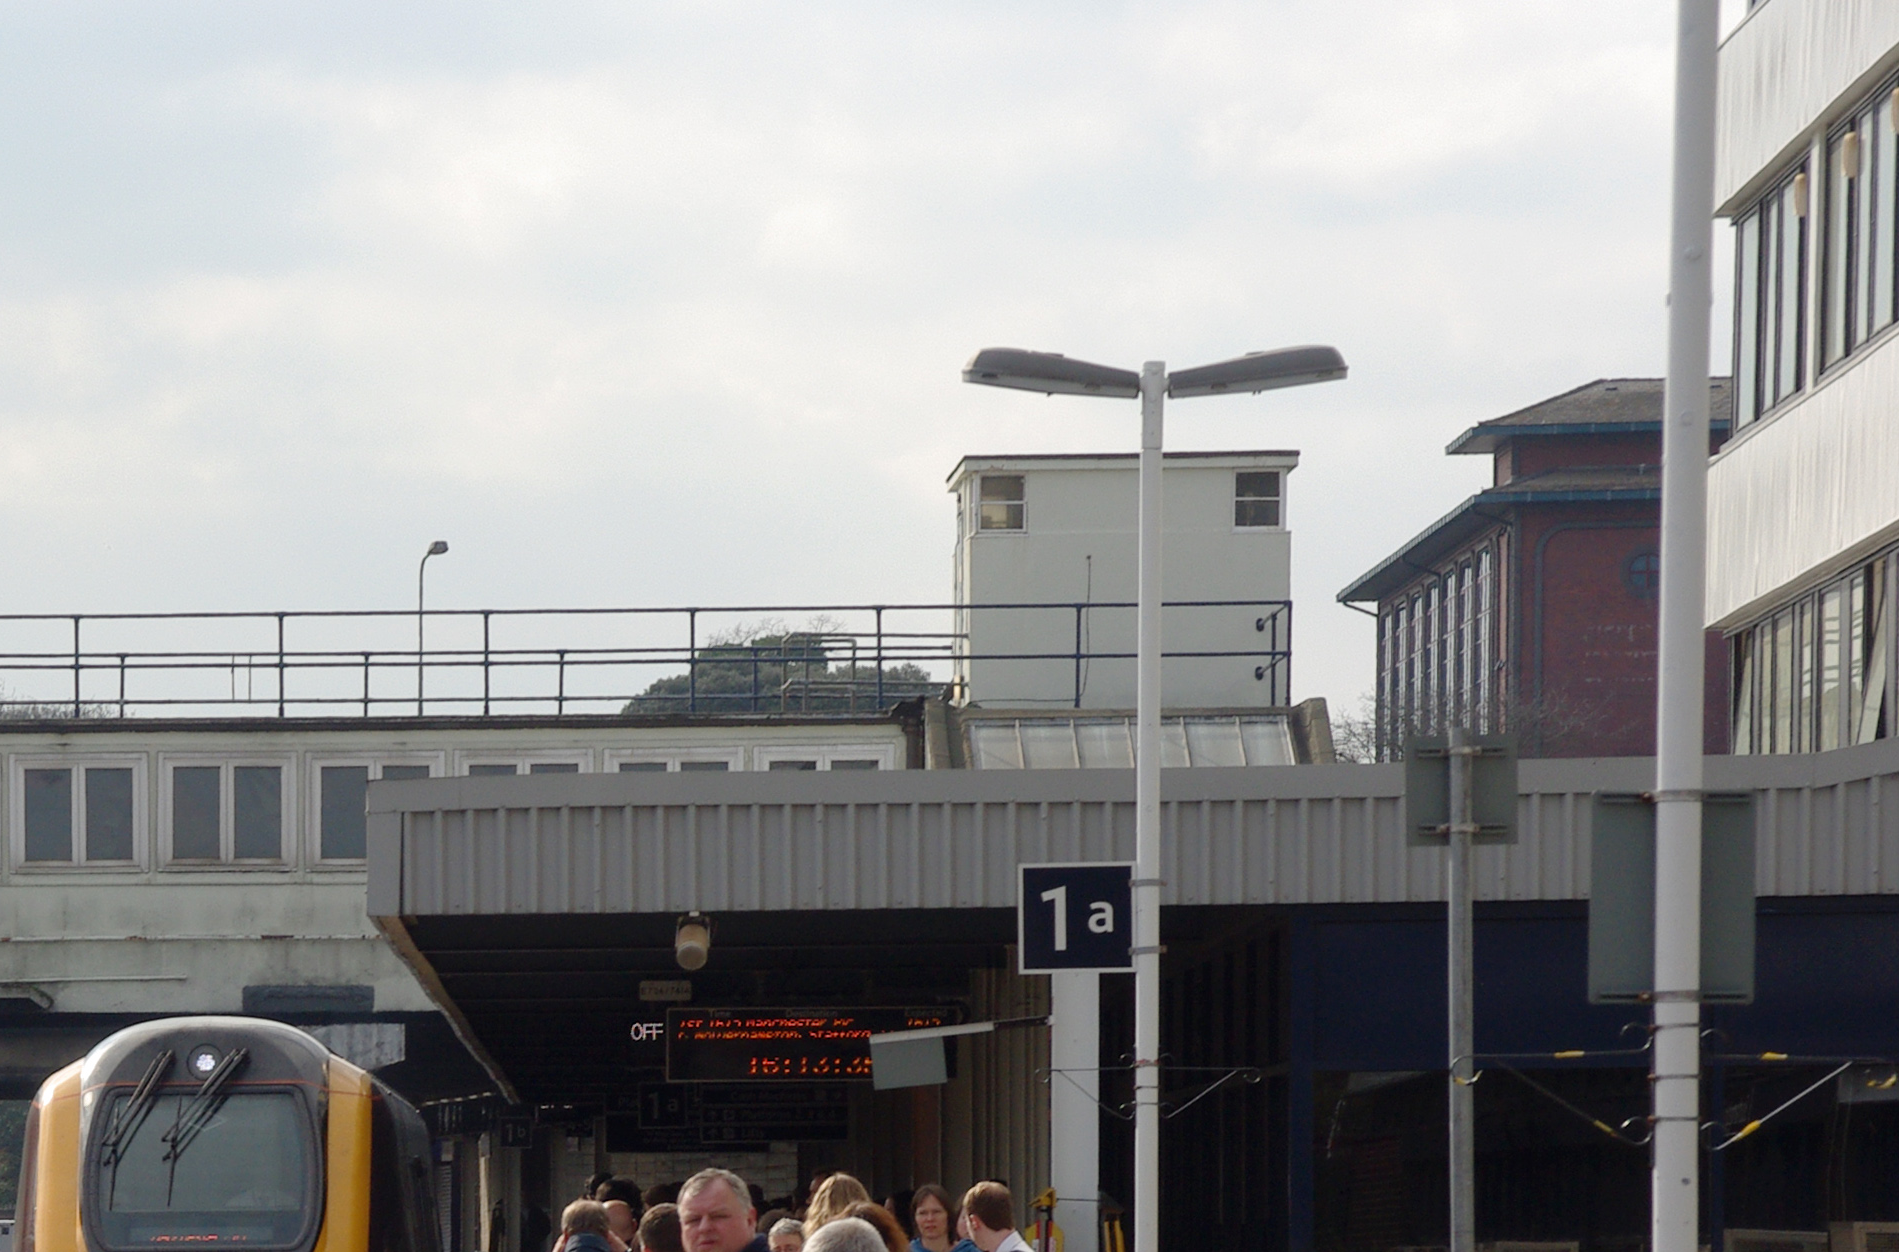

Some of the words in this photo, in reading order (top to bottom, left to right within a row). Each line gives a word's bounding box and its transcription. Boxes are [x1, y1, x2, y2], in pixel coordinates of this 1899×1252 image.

[1040, 886, 1115, 952] 1a
[630, 1022, 664, 1042] OFF
[647, 1092, 679, 1120] 1a
